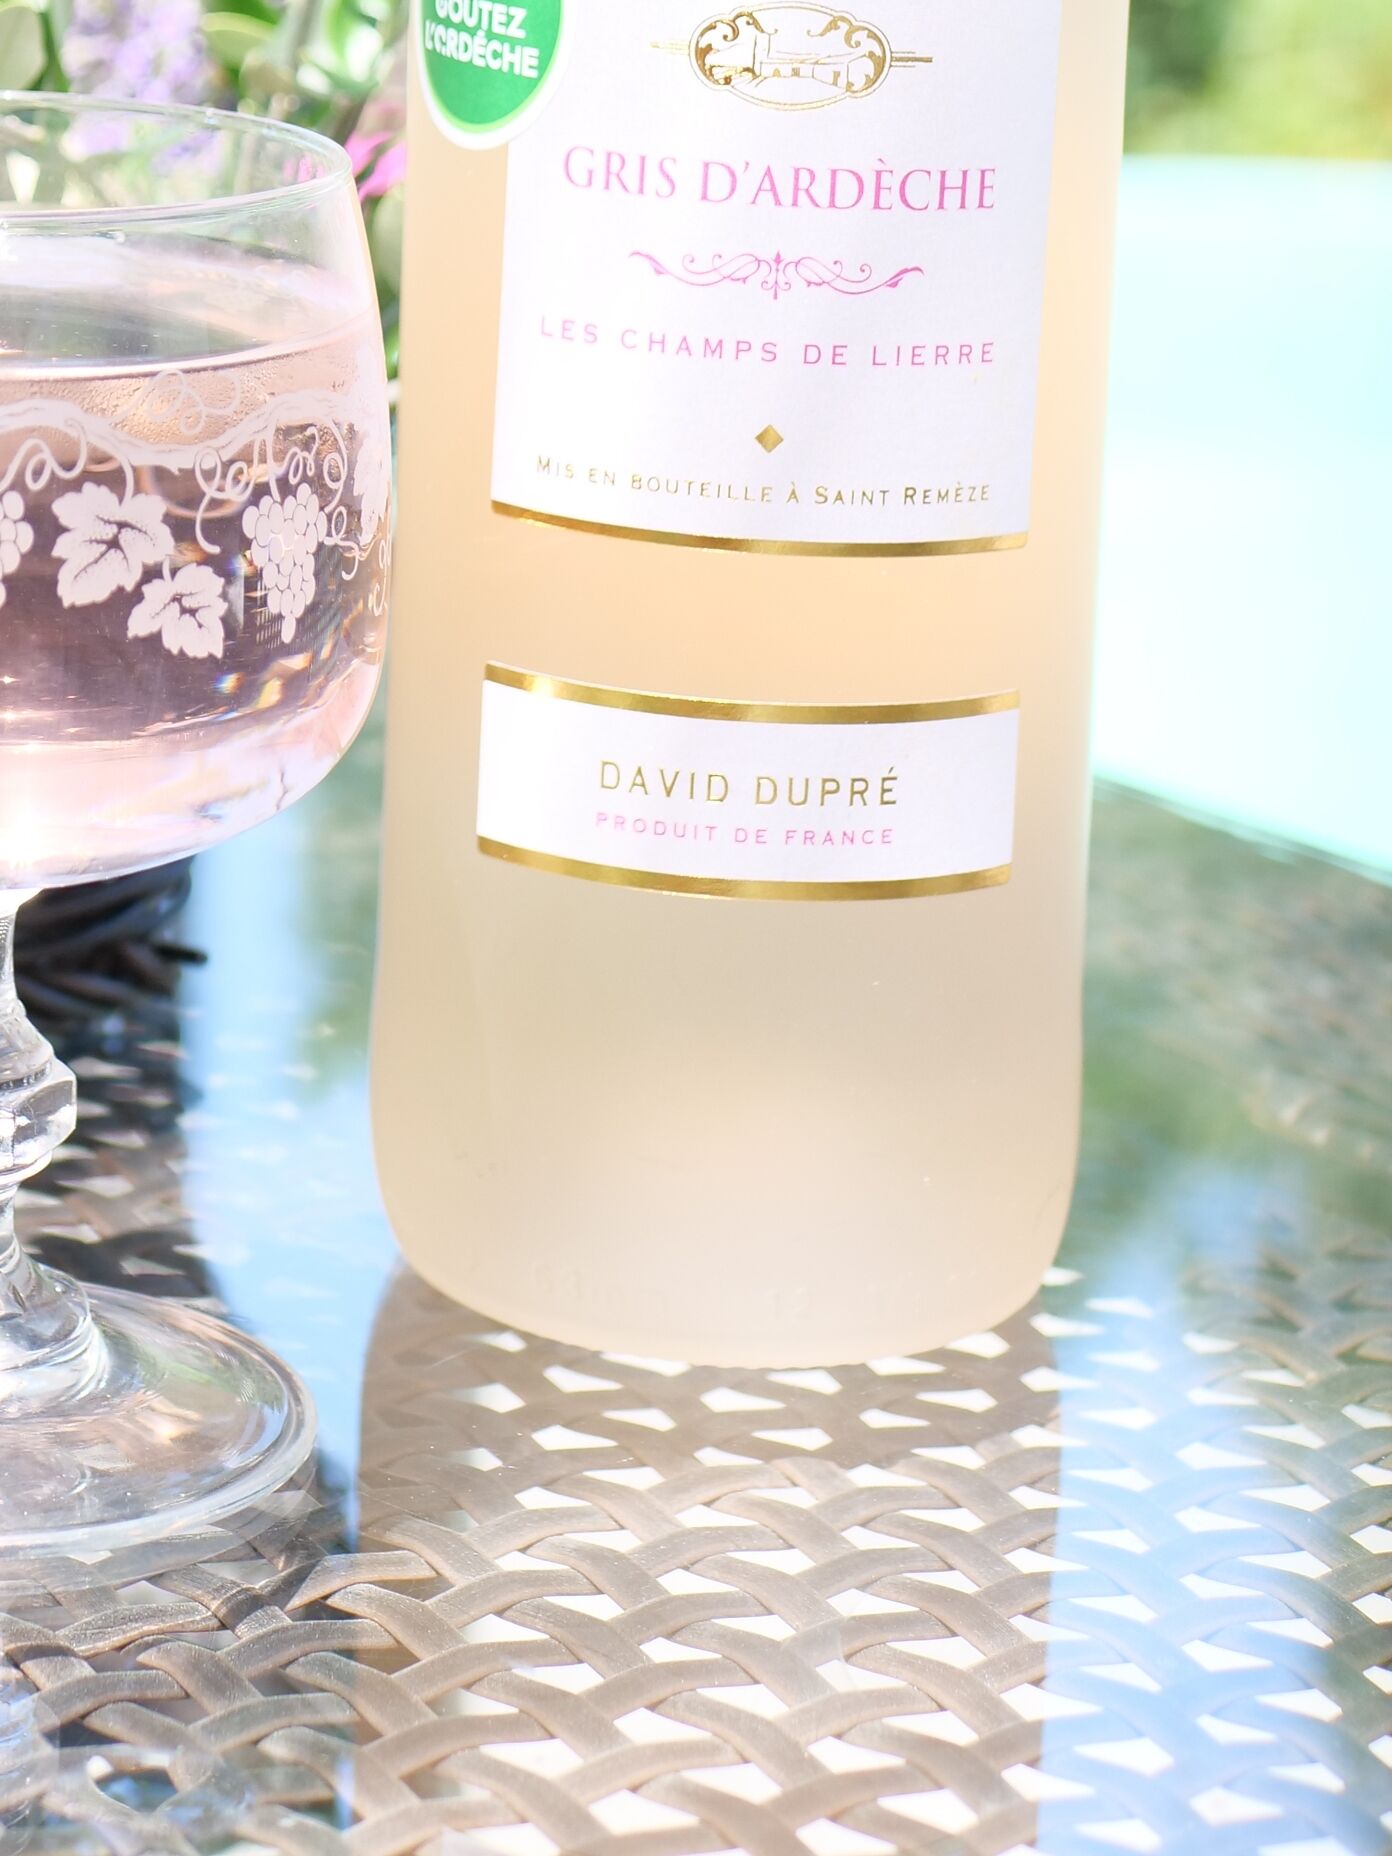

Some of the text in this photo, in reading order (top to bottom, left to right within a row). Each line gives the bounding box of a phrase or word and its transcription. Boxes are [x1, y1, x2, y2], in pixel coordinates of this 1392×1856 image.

[562, 145, 997, 214] GRIS D'ARDÈCHE
[540, 315, 995, 369] LES CHAMPS DE LIERRE
[586, 466, 617, 487] EN
[629, 472, 775, 504] BOUTEILLE
[785, 480, 802, 505] À
[813, 484, 891, 508] SAINT
[598, 758, 900, 808] DAVID DUPRÉ
[595, 811, 894, 847] PRODUIT DE FRANCE
